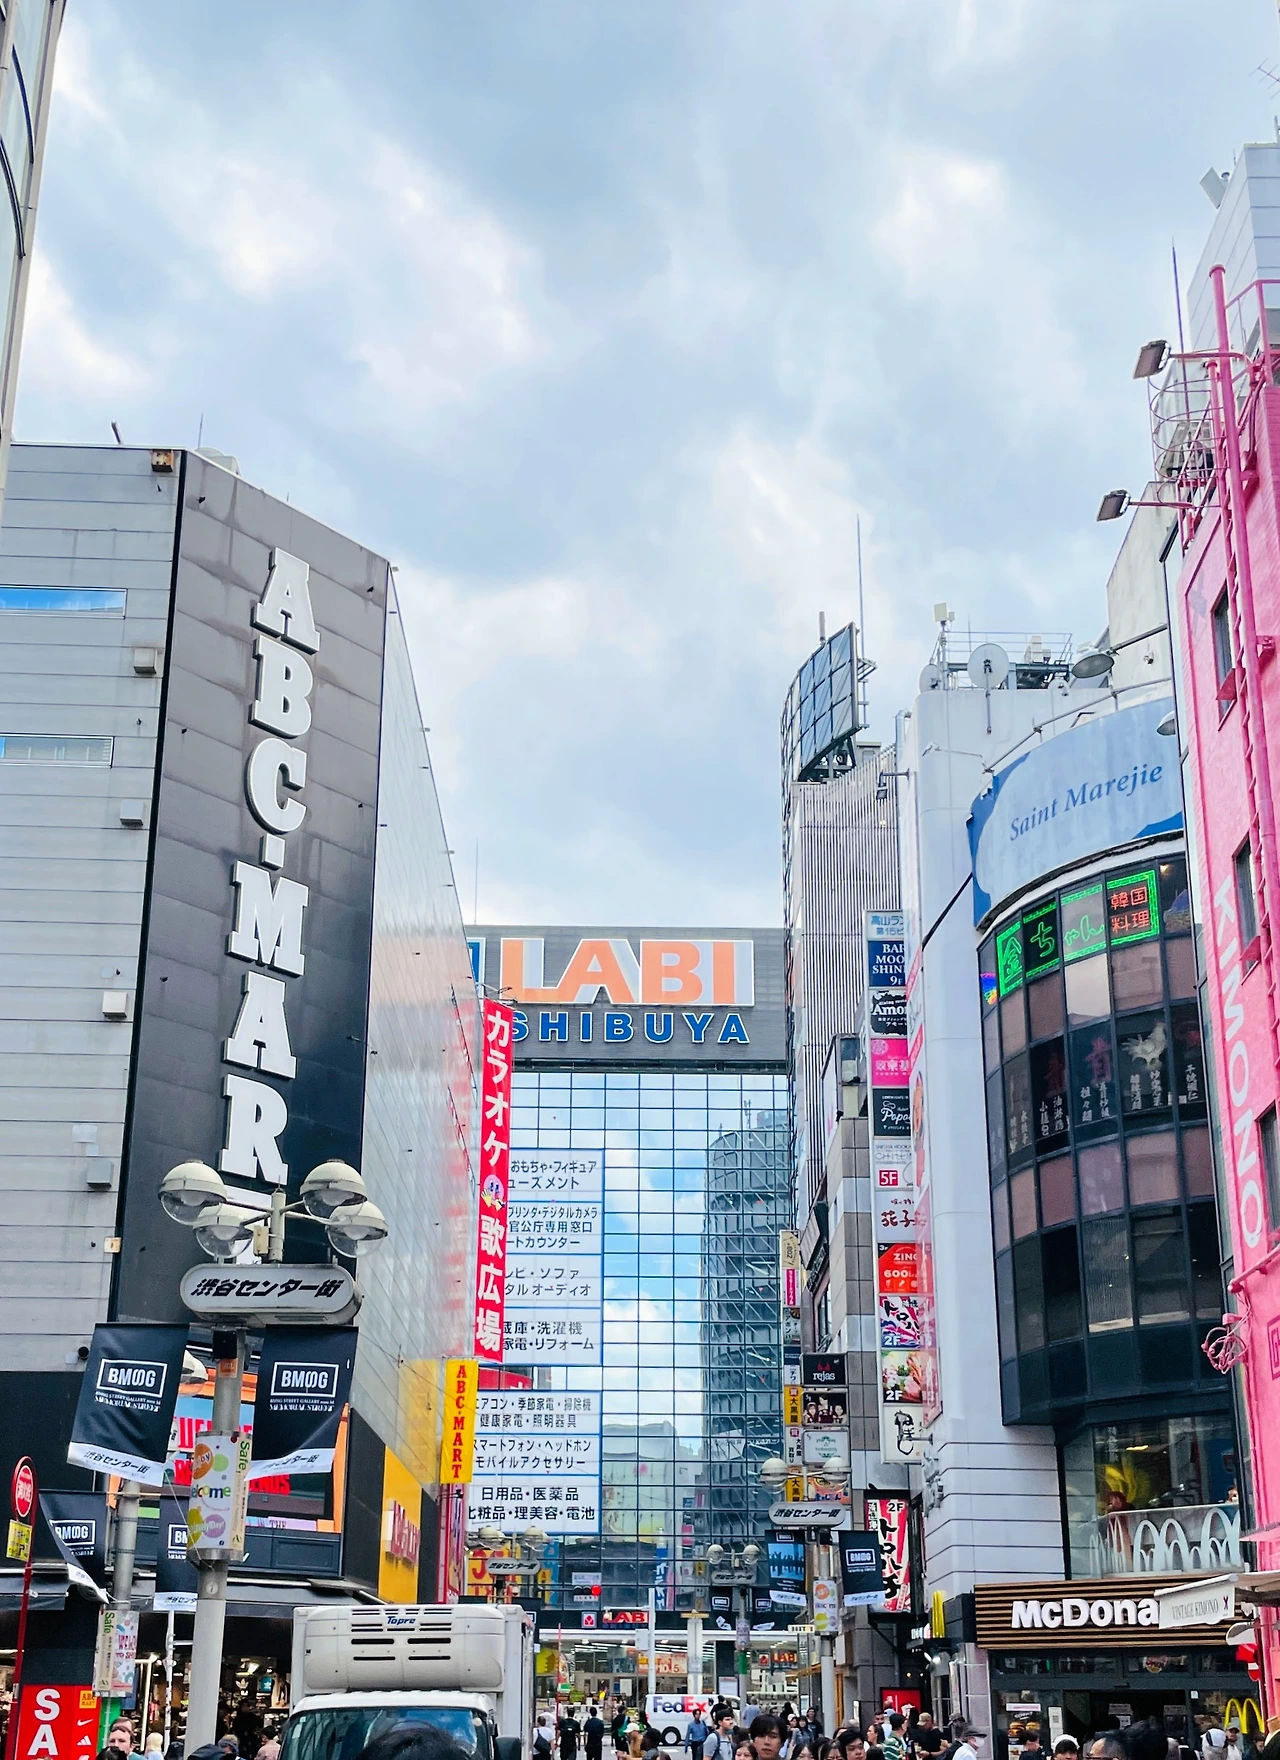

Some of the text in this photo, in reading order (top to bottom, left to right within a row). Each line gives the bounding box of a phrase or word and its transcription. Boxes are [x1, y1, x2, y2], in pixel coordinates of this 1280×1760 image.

[1010, 763, 1163, 841] Saint Marejie
[1110, 886, 1148, 911] 韓国
[1111, 909, 1150, 933] 料理
[875, 955, 905, 964] MOO
[500, 937, 754, 1006] LABI
[872, 965, 906, 974] SHIN
[511, 1010, 750, 1044] SHIBUYA
[1215, 874, 1262, 1248] KIMONO
[483, 1010, 510, 1167] カラオケ
[508, 1177, 580, 1190] ューズメント
[880, 1171, 897, 1186] 5F
[506, 1236, 580, 1248] ートカウンター
[504, 1267, 580, 1279] レビ・ソファ
[195, 1277, 344, 1301] 渋谷センター街
[475, 1214, 505, 1353] 歌広場
[504, 1284, 591, 1296] タルオーディオ
[502, 1321, 583, 1335] 蔵庫・洗濯機
[884, 1335, 900, 1346] 2F
[812, 1370, 836, 1382] rejas
[886, 1390, 903, 1400] 2F
[475, 1456, 586, 1469] モバイルアクセサリー
[482, 1487, 579, 1501] 日用品・医薬品
[888, 1502, 905, 1512] 2F
[1011, 1598, 1159, 1629] McDona
[1194, 1598, 1219, 1619] KIMONO
[387, 1616, 416, 1625] Topre
[602, 1611, 649, 1624] LAB
[652, 1696, 708, 1713] FedEx
